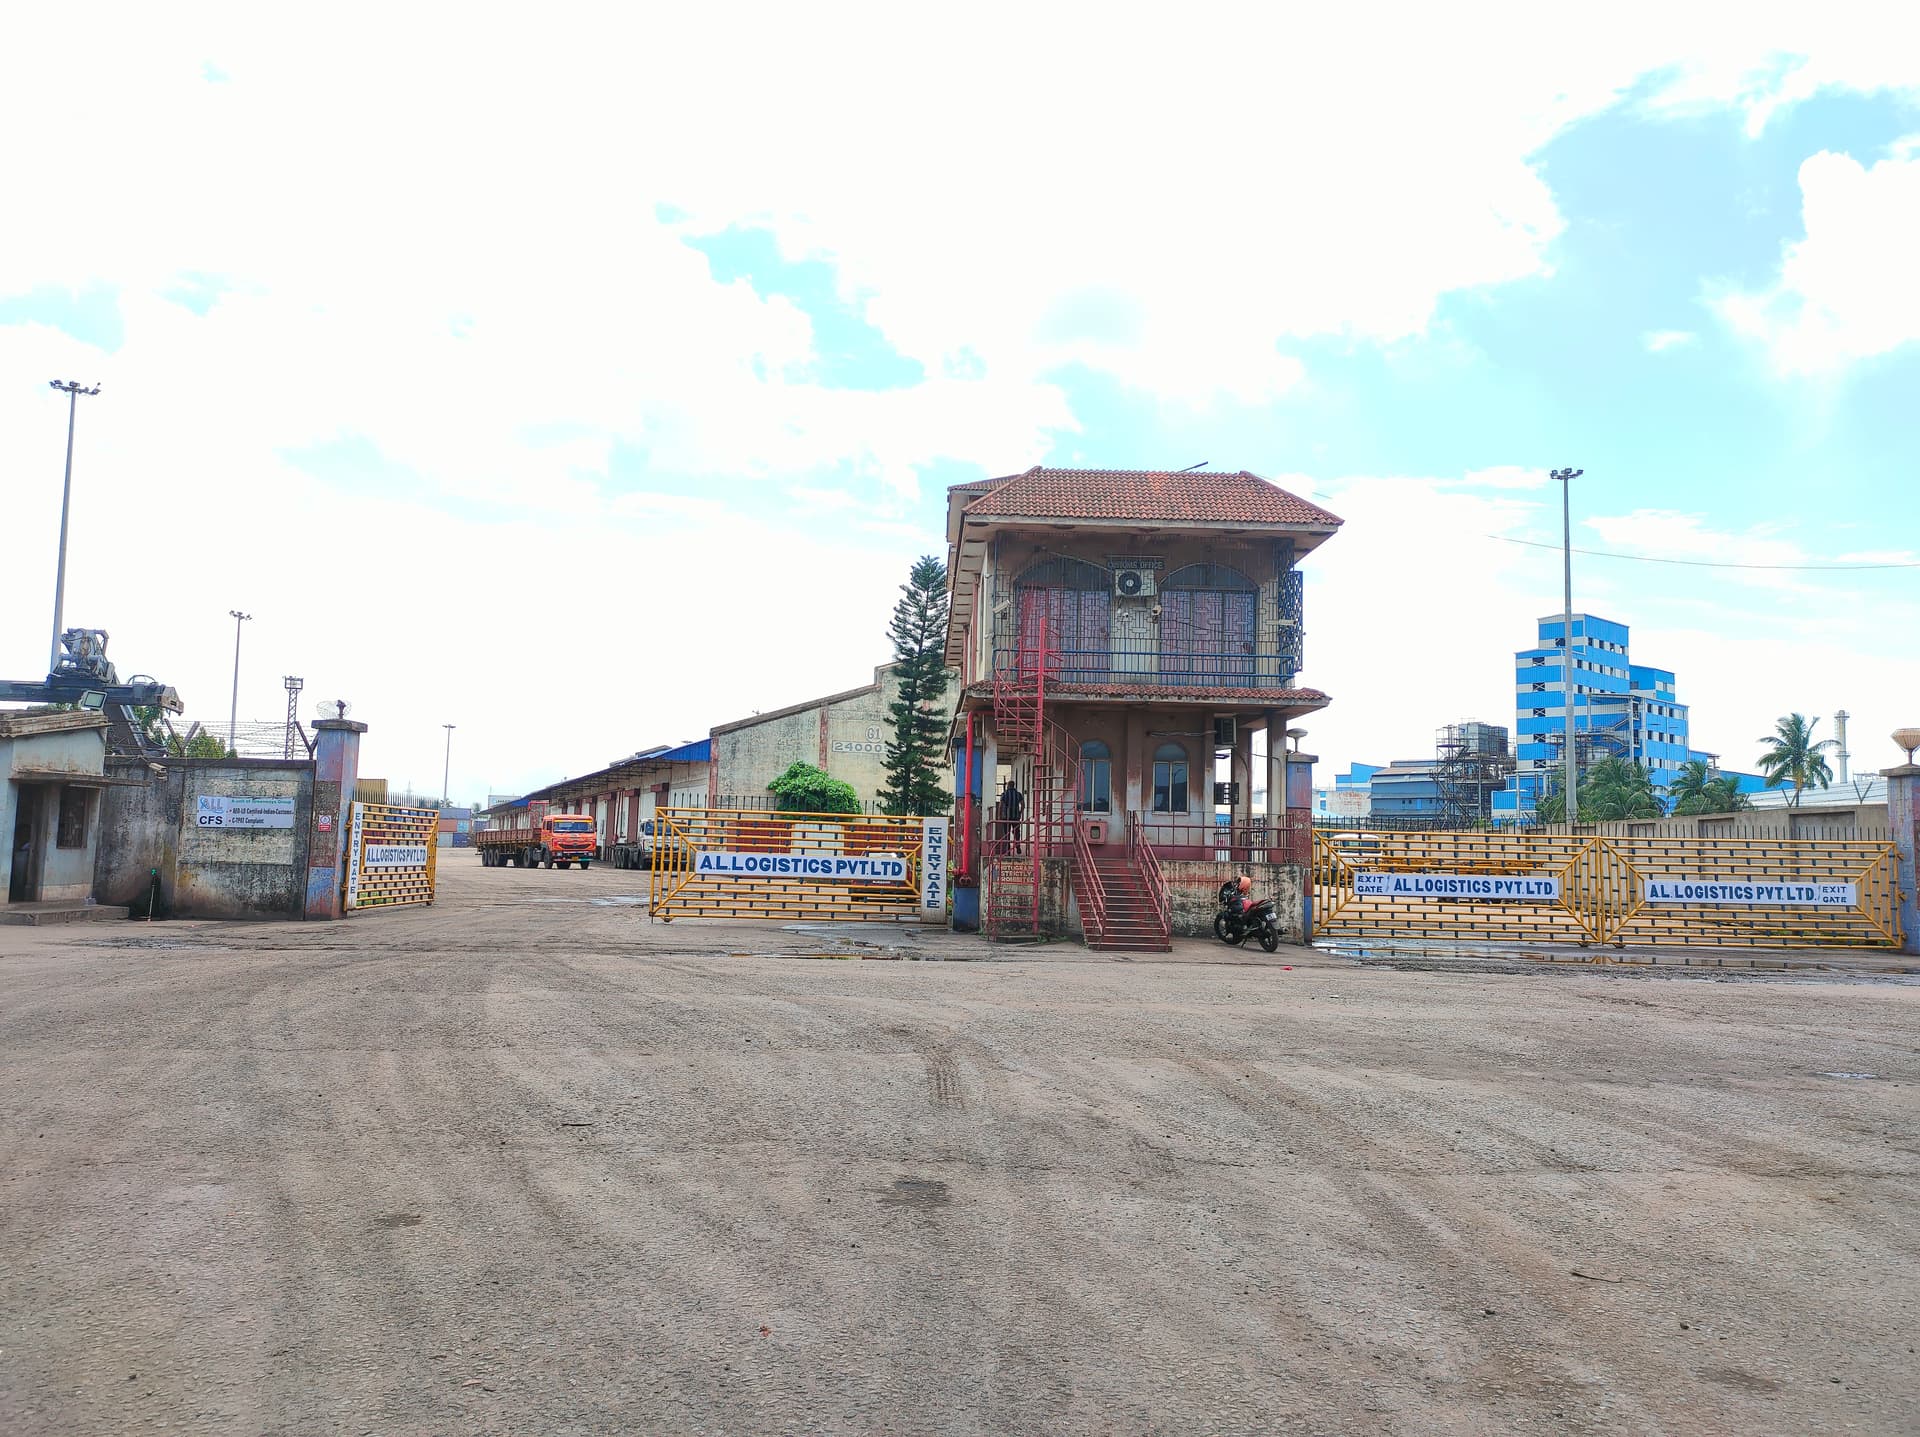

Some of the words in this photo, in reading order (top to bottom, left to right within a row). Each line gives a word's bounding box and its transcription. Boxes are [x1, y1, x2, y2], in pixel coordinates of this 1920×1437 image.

[1139, 561, 1164, 570] OFFICE
[200, 816, 222, 825] CFS
[352, 812, 361, 857] ENTRY
[927, 827, 942, 871] ENTRY
[349, 859, 358, 894] GATE
[1357, 875, 1385, 883] EXIT
[926, 872, 941, 909] GATE
[1357, 885, 1383, 893] GATE
[1415, 879, 1491, 894] LOGISTICS
[1674, 885, 1753, 900] LOGISTICS
[1822, 886, 1847, 894] EXIT
